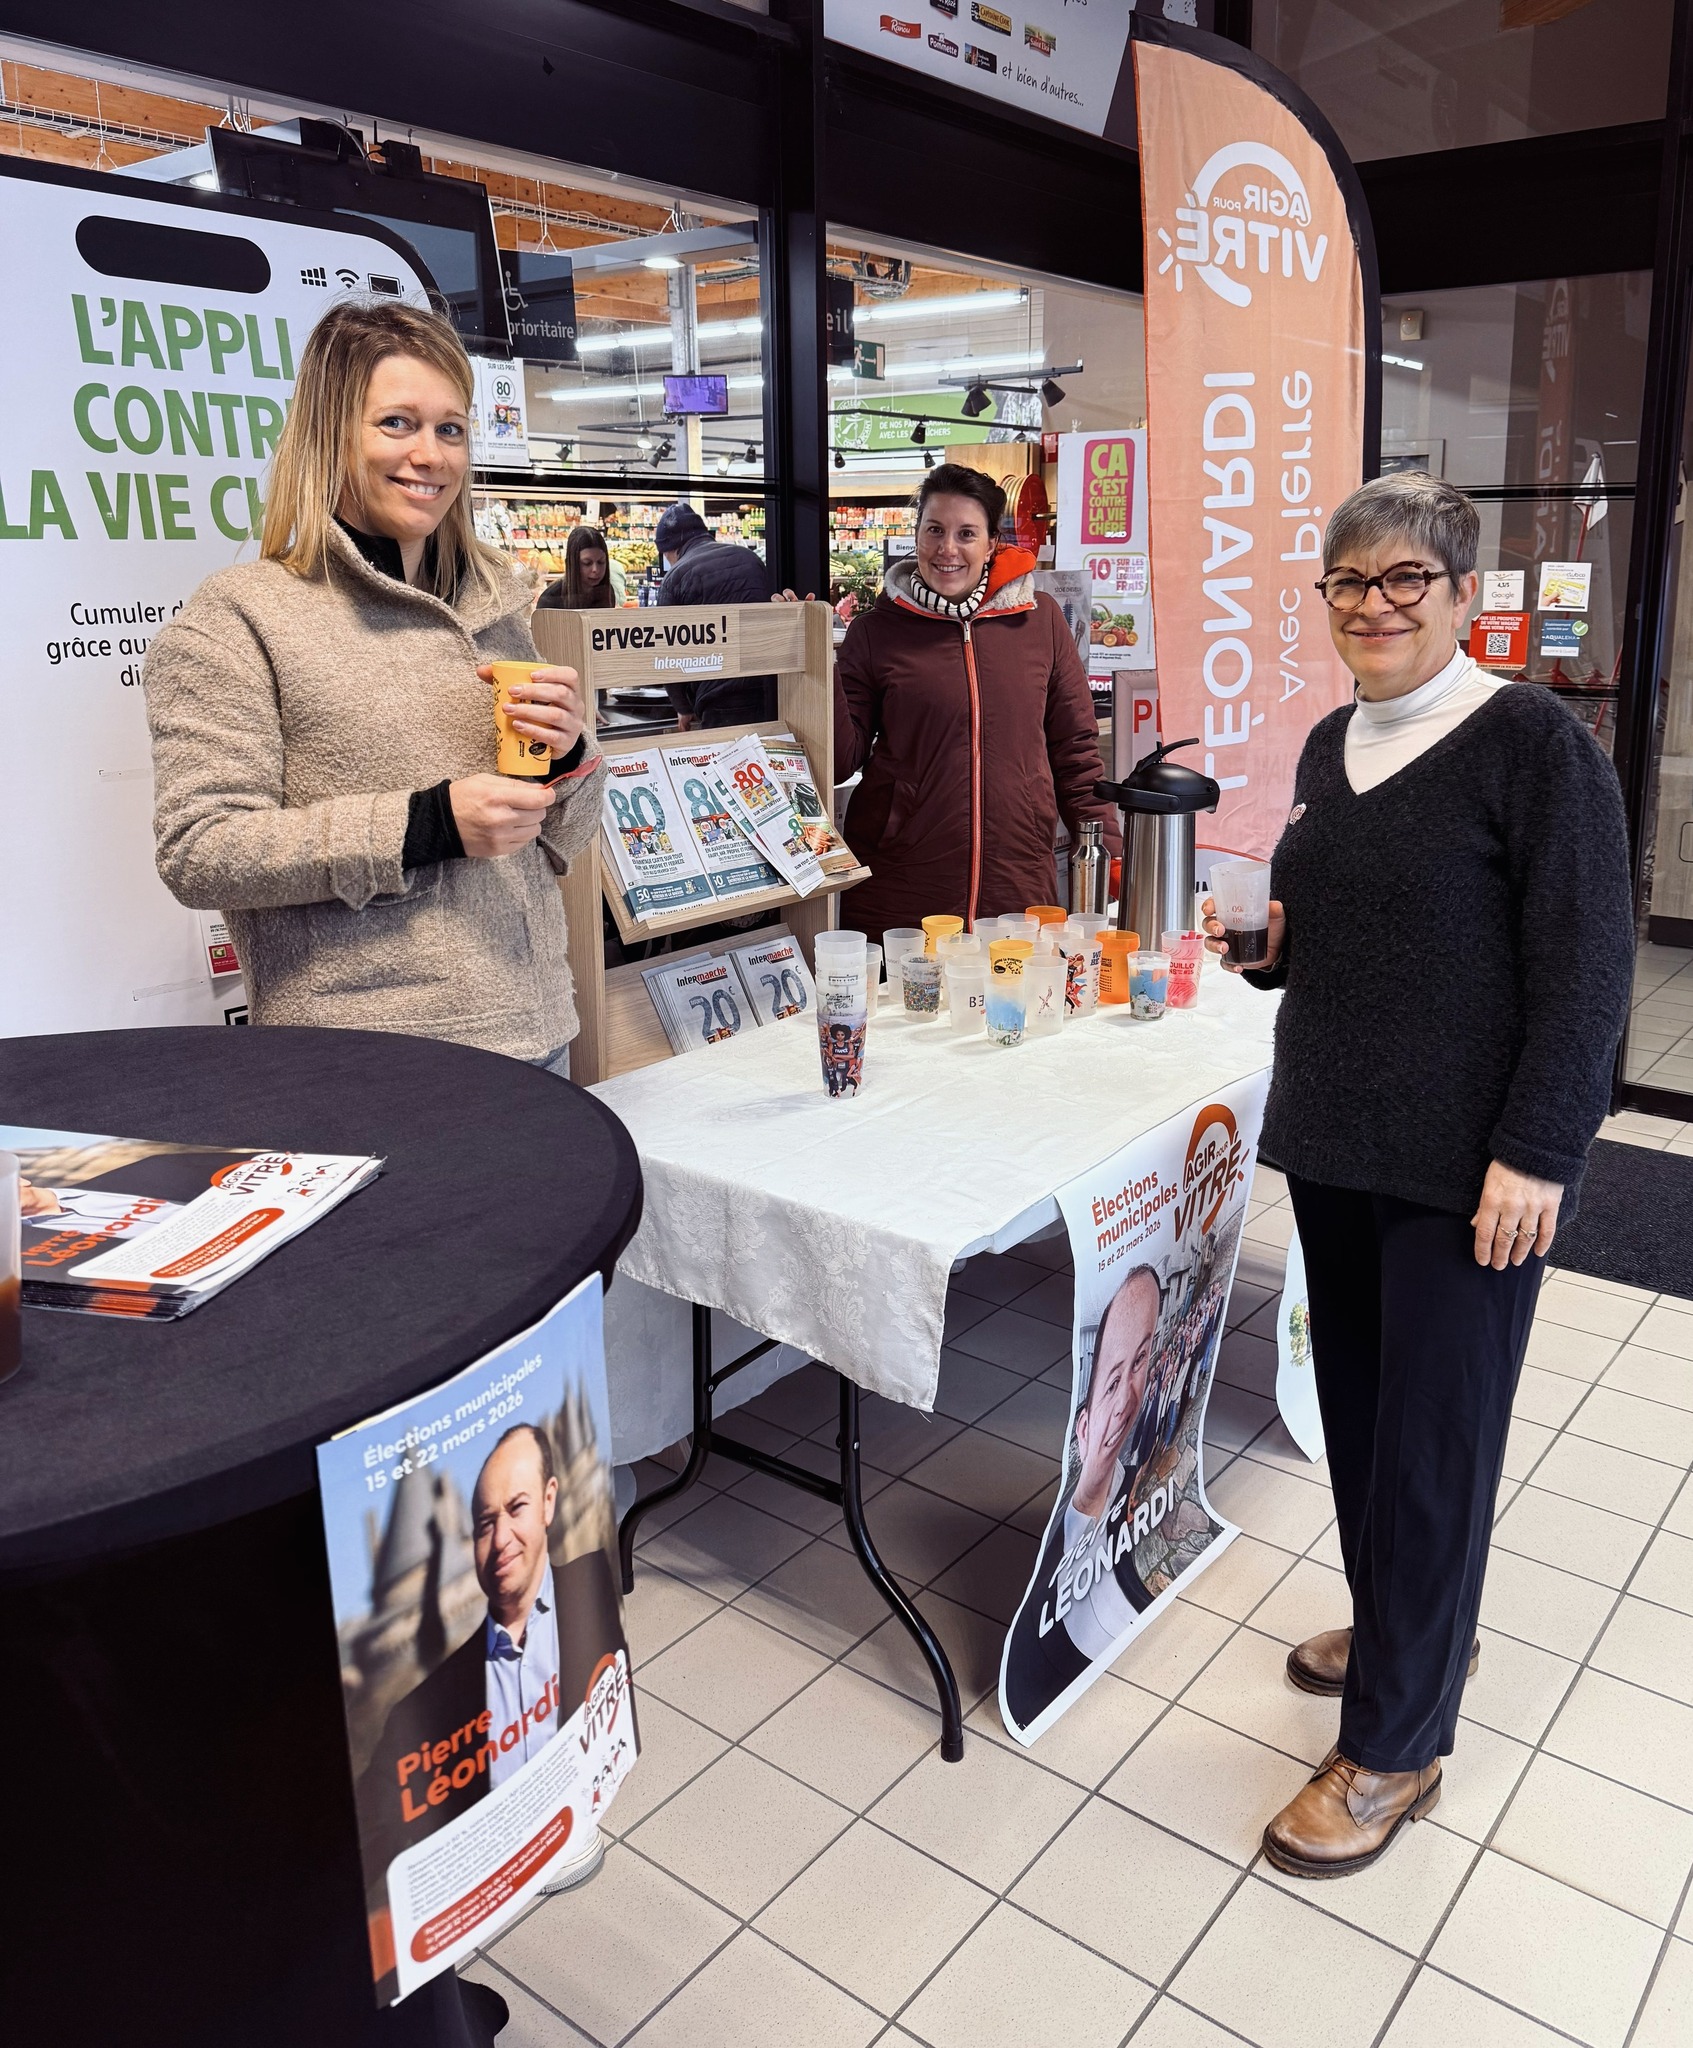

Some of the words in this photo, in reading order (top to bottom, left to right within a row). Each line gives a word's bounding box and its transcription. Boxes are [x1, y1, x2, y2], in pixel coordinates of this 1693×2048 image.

[891, 19, 911, 34] Ranou
[930, 37, 957, 56] Pommette
[1002, 61, 1012, 79] et
[1017, 66, 1037, 88] bien
[73, 382, 293, 460] CONTR
[880, 431, 895, 439] AVEC
[897, 430, 909, 438] LES
[1091, 443, 1128, 479] ÇA
[0, 469, 78, 540] LA
[86, 472, 196, 541] VIE
[210, 475, 266, 541] CH
[1089, 496, 1127, 508] CONTRE
[1089, 508, 1104, 521] LA
[1107, 507, 1126, 521] VIE
[1116, 558, 1130, 566] SUR
[1116, 581, 1144, 591] FRAIS
[1491, 591, 1515, 599] Google
[70, 602, 165, 627] Cumuler
[721, 616, 727, 643] !
[47, 636, 111, 665] grâce
[119, 638, 151, 655] au
[654, 653, 724, 672] Intermarché
[669, 752, 720, 767] Intermar
[684, 778, 728, 819] 8
[748, 946, 793, 966] Intermarché
[677, 966, 727, 988] Intermarché
[229, 1157, 289, 1196] VITRÉ
[1183, 1140, 1215, 1193] AGIR
[1091, 1171, 1158, 1227] Élections
[1174, 1131, 1242, 1243] VITRÉ
[24, 1197, 169, 1267] Léonardi
[1097, 1182, 1178, 1252] municipales
[1098, 1261, 1106, 1273] 15
[1107, 1254, 1115, 1267] et
[1116, 1248, 1125, 1261] 22
[1126, 1233, 1144, 1254] mars
[1145, 1220, 1161, 1239] 2026
[363, 1414, 452, 1469] Élections
[454, 1354, 543, 1421] municipales
[364, 1472, 387, 1492] 15
[391, 1457, 414, 1481] et
[416, 1444, 440, 1468] 22
[441, 1416, 486, 1454] mars
[488, 1391, 524, 1426] 2026
[1038, 1476, 1175, 1639] LÉONARDI
[1049, 1494, 1127, 1589] Pierre
[397, 1709, 493, 1786] Pierre
[401, 1673, 560, 1823] Léonardi
